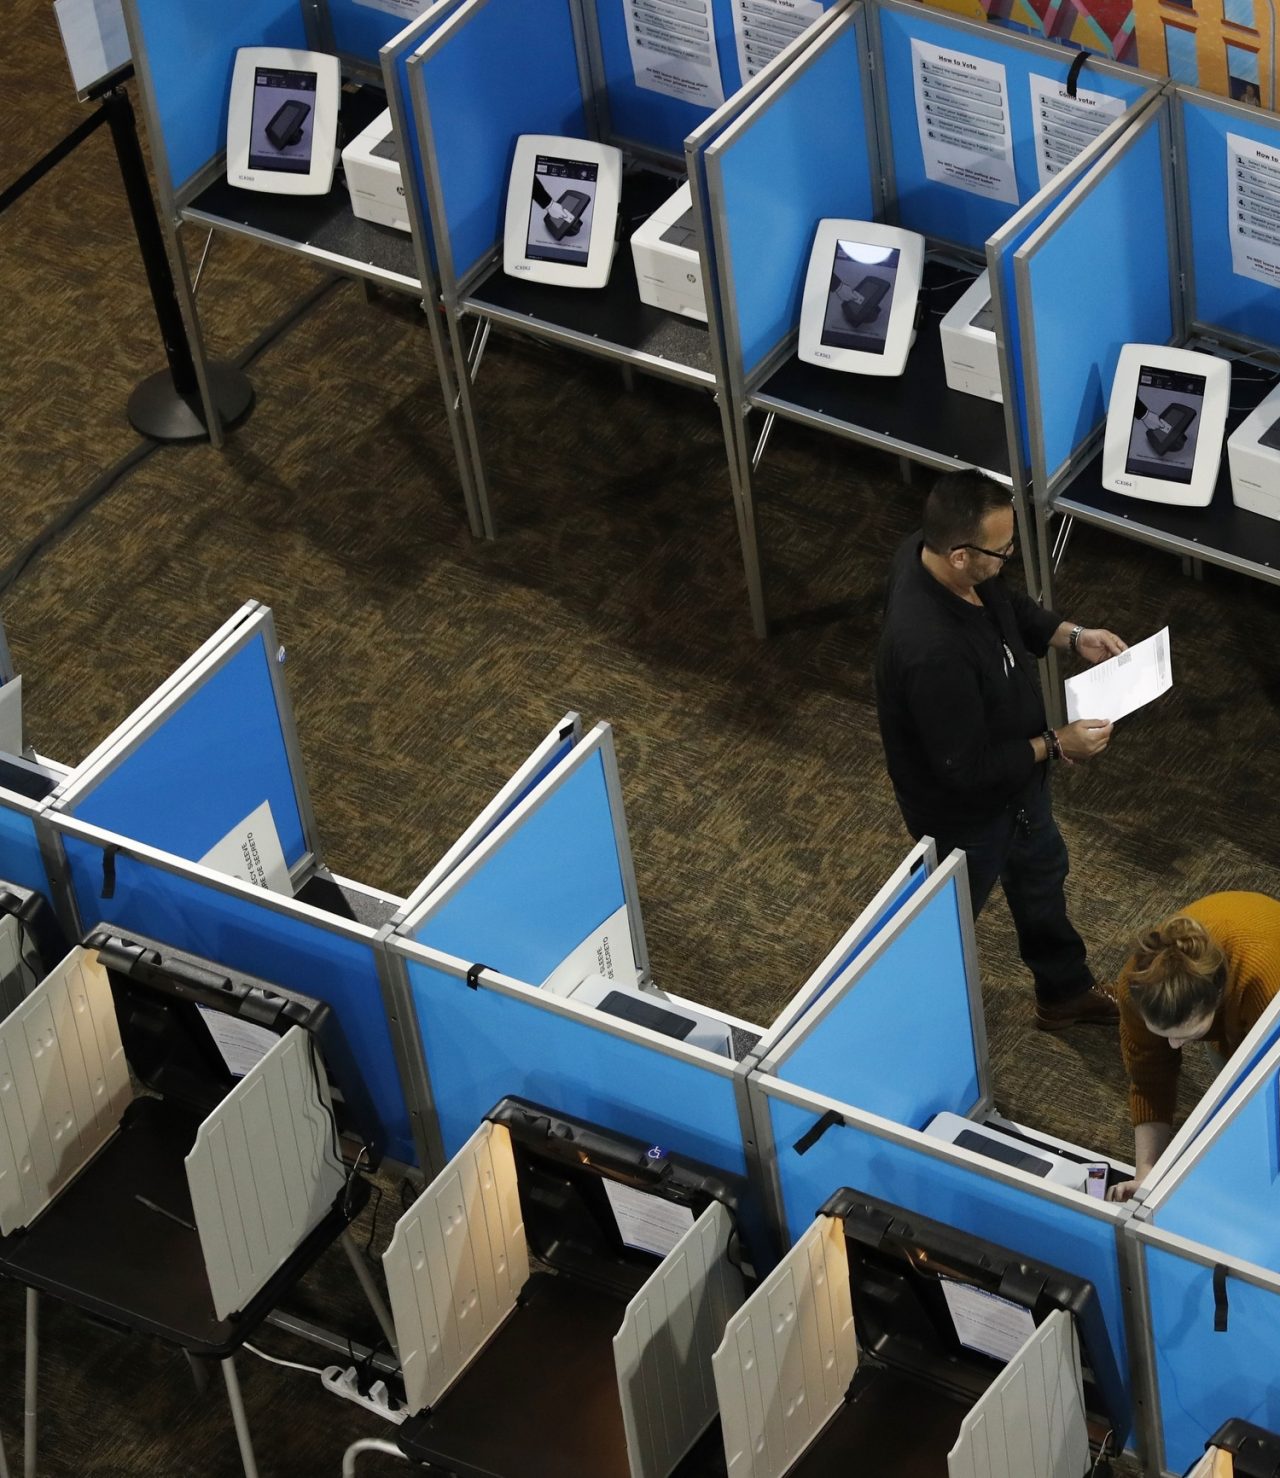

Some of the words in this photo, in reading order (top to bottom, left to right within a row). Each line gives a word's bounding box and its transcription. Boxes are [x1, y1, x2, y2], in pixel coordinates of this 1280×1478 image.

[1256, 150, 1269, 160] How
[1271, 155, 1278, 163] to
[242, 842, 253, 870] SLEEVE
[246, 832, 261, 866] SECRETO
[256, 865, 264, 877] DE
[603, 936, 612, 969] SECRETO
